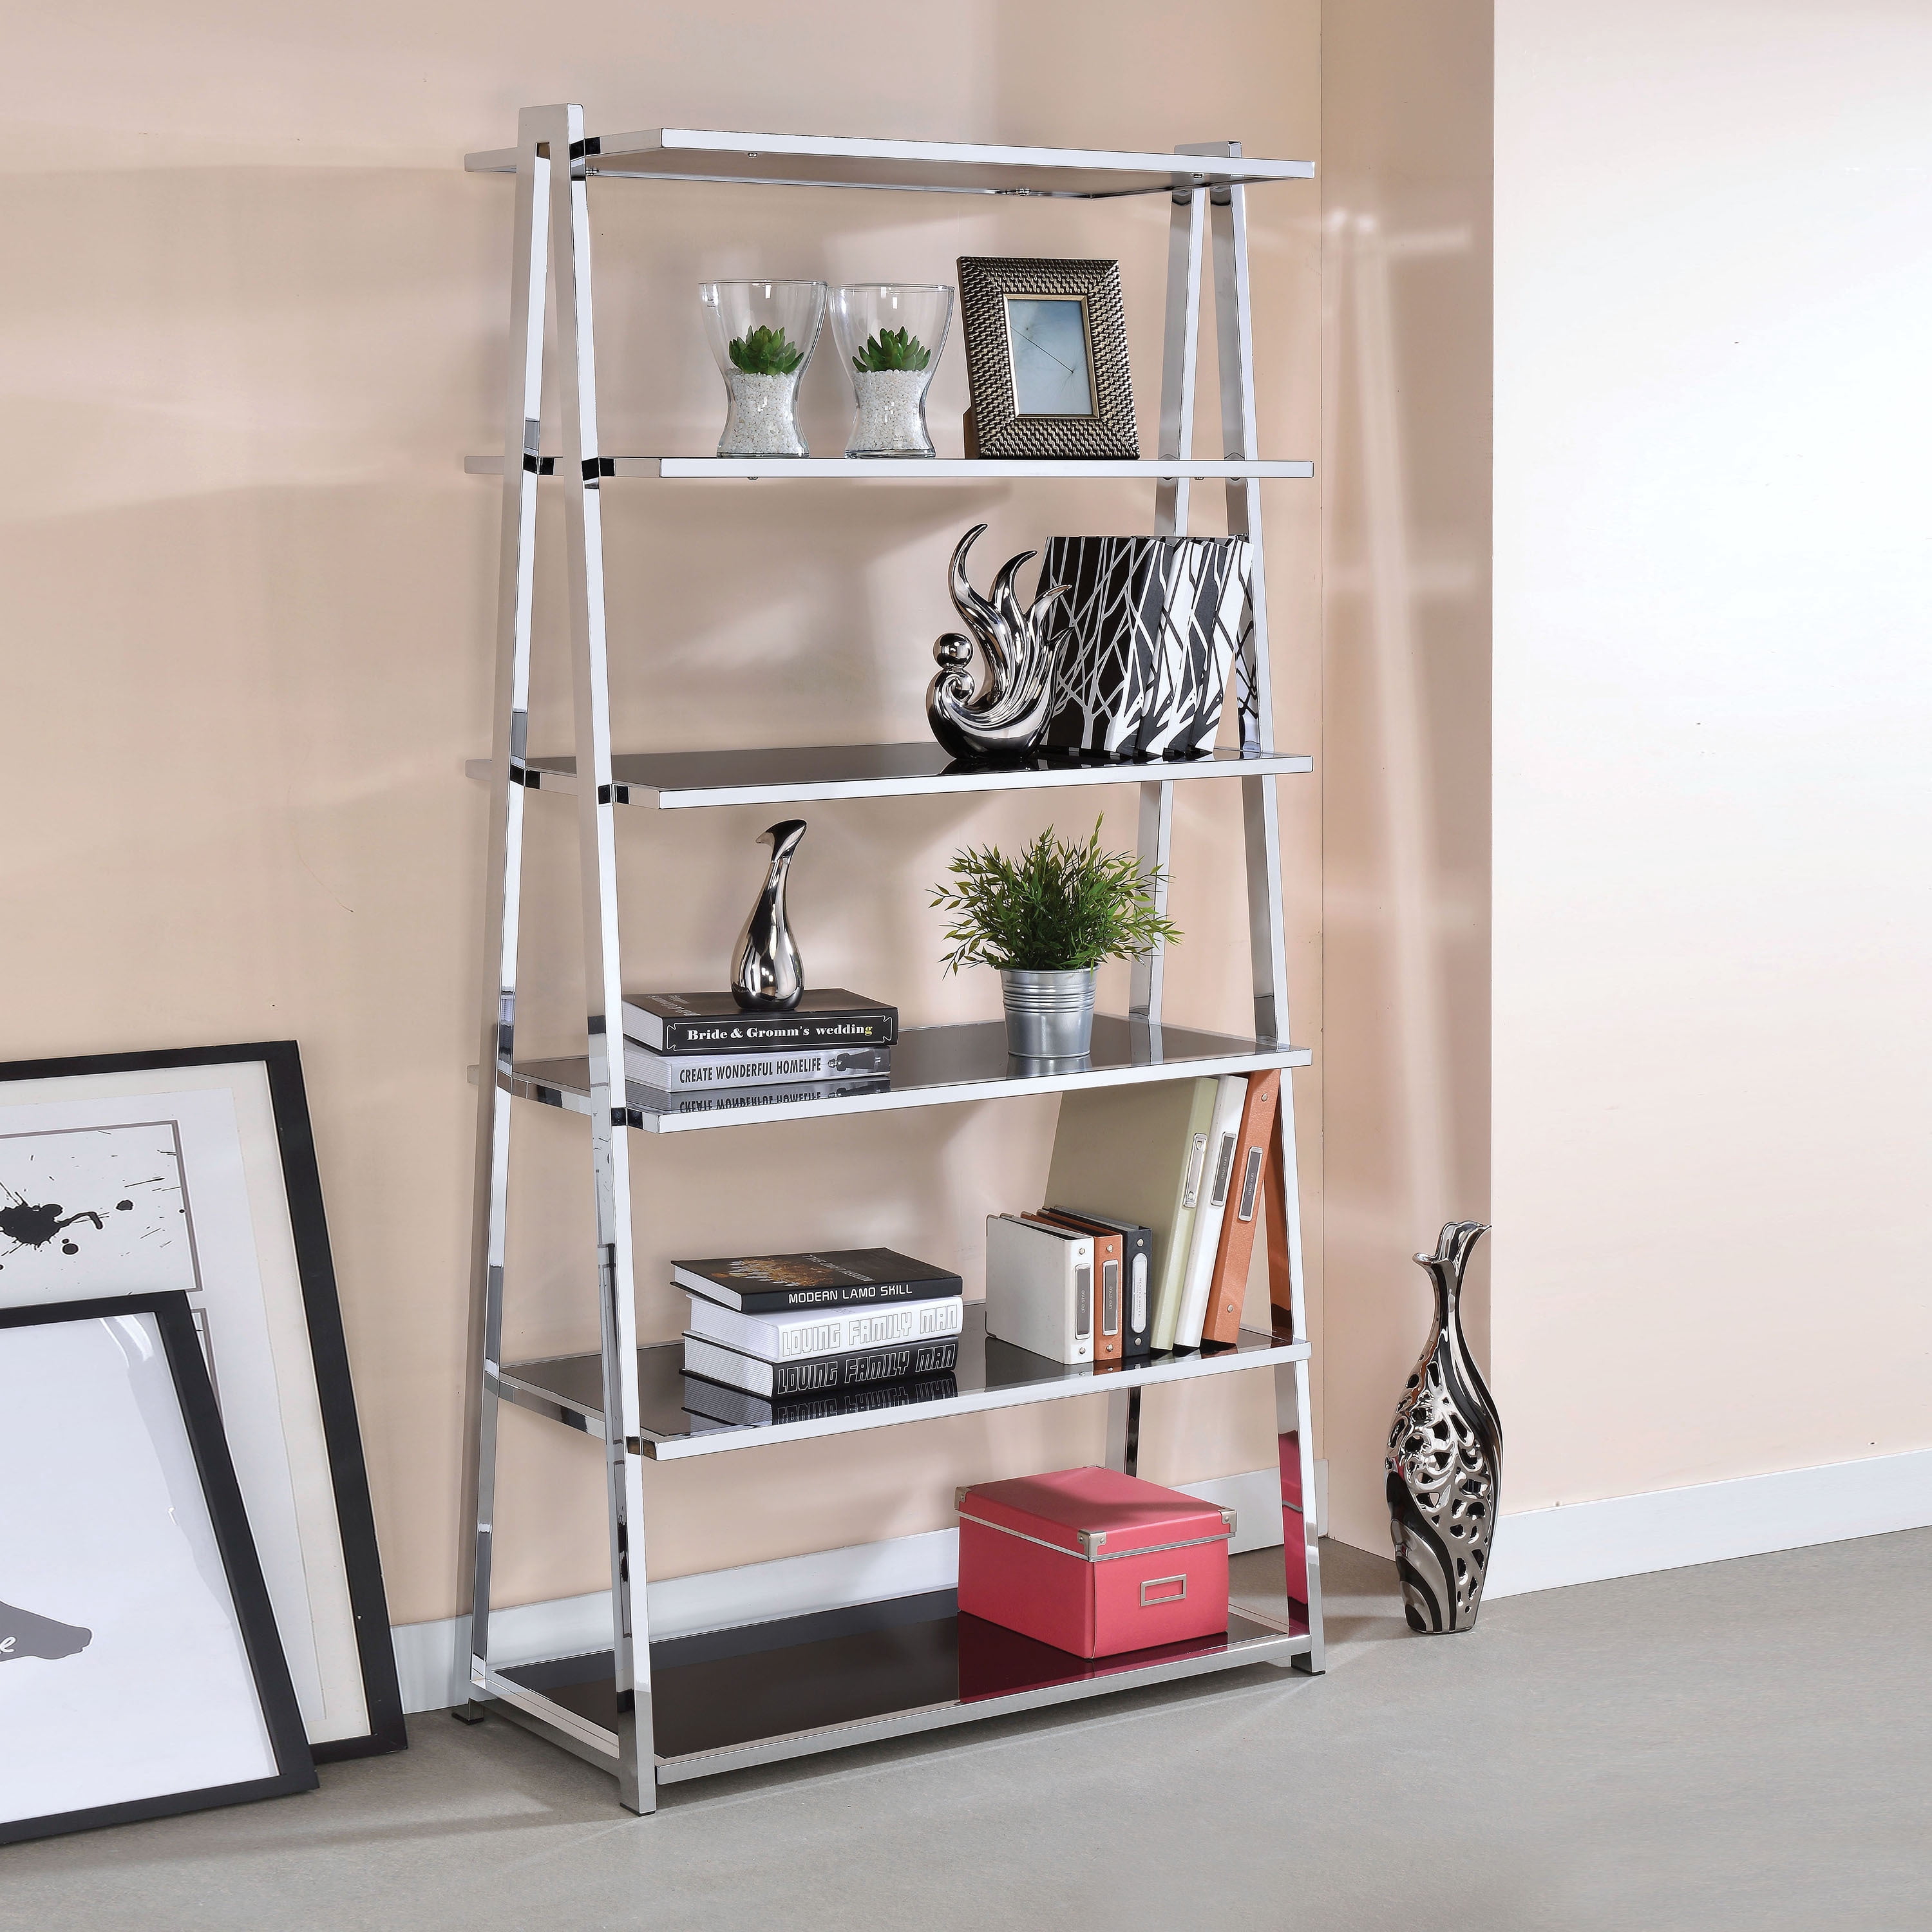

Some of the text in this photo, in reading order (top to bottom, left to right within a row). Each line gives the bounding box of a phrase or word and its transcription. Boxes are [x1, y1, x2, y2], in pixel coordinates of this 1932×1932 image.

[687, 1024, 873, 1041] Bride & Gromm's wedding
[679, 1057, 821, 1083] CREATE WONDERFUL HOMELIFE
[788, 1284, 913, 1304] MODERN LAMO SKILL
[782, 1304, 958, 1357] LOVING FAMILY MAN
[777, 1343, 956, 1395] LOVING FAMILY MAN
